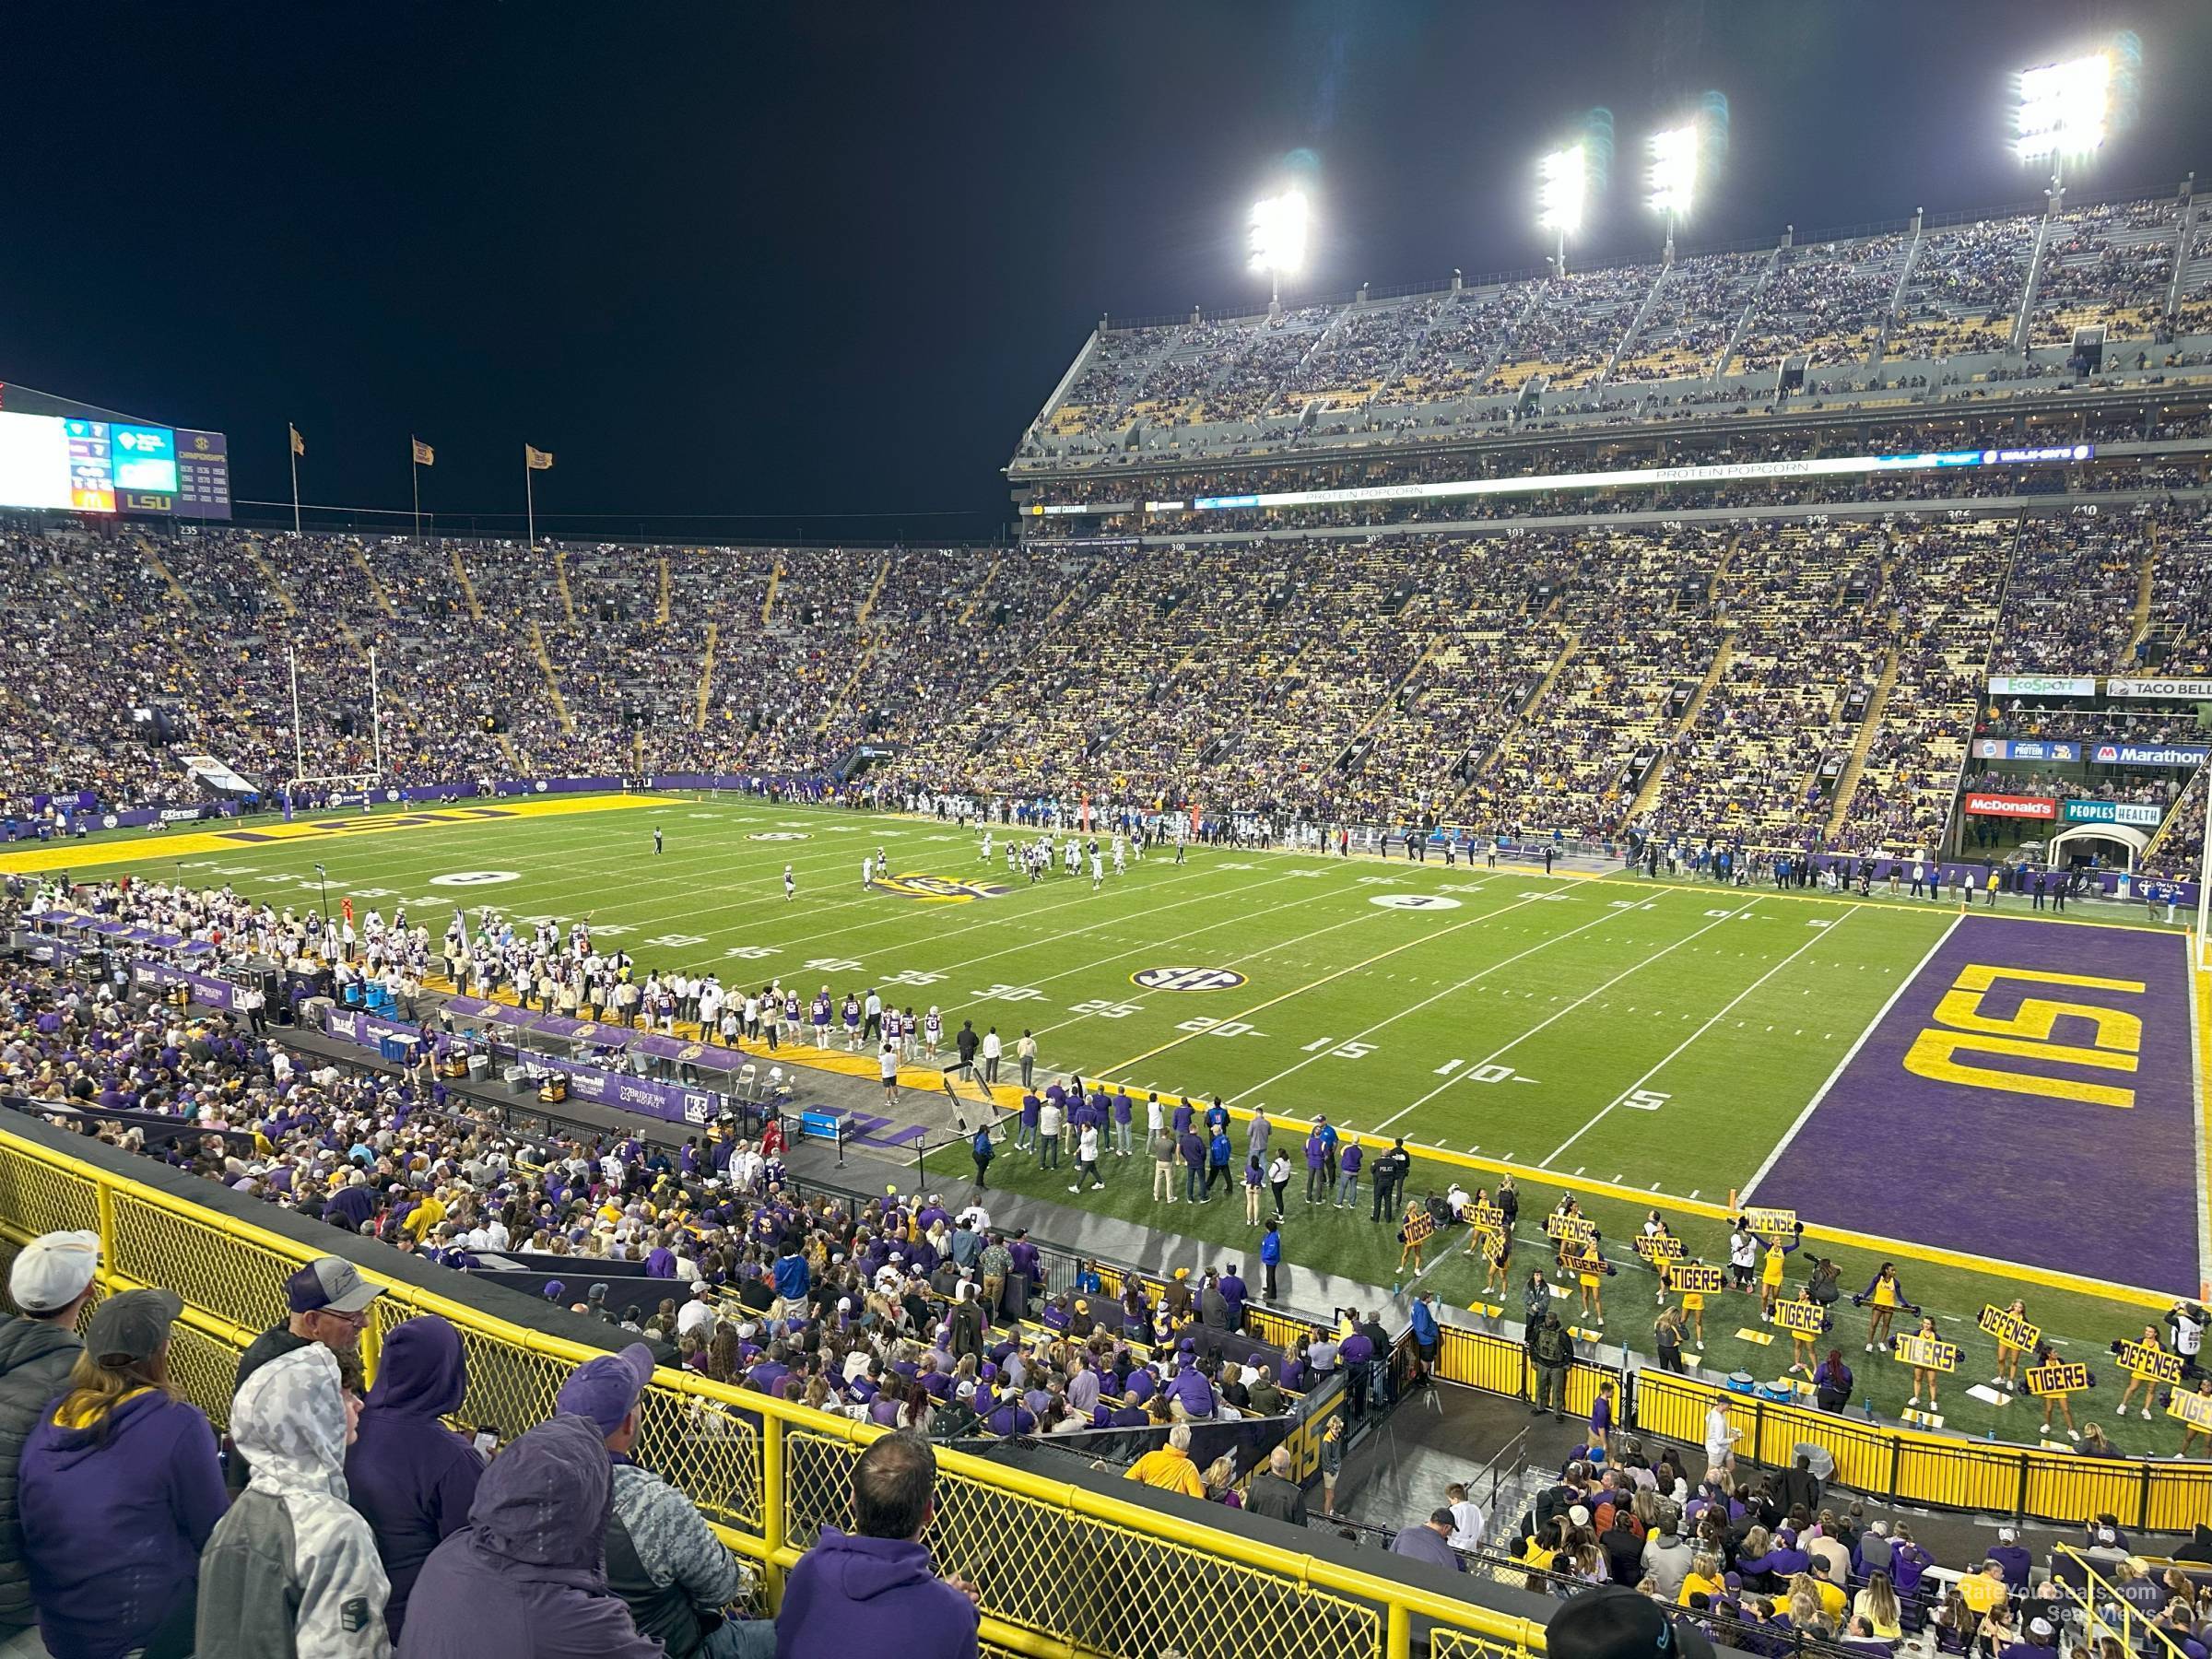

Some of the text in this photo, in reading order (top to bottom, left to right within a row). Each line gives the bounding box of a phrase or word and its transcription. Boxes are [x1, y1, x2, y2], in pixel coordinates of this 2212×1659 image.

[1656, 462, 1810, 480] PROTEIN POPCORN
[127, 493, 171, 511] LSU
[1306, 486, 1425, 501] PROTEIN POPCORN
[180, 525, 197, 535] 235
[1505, 528, 1524, 537] 303
[2008, 678, 2075, 691] EcoSport
[2136, 684, 2212, 695] TACO BELL
[2015, 746, 2043, 756] PROTEIN
[2120, 748, 2204, 764] Marathon
[623, 779, 652, 788] LU
[1971, 799, 2051, 814] McDonald's
[2070, 806, 2158, 822] PEOPLES HEALTH
[214, 808, 519, 841] LSU
[643, 934, 708, 947] 50
[724, 946, 783, 959] 45
[803, 958, 854, 972] 40
[879, 970, 950, 986] 35
[1140, 968, 1239, 990] SEC
[970, 983, 1042, 1002] 30
[786, 1003, 796, 1013] 42
[813, 1004, 823, 1015] 98
[848, 1004, 858, 1015] 68
[1068, 1000, 1146, 1018] 25
[927, 1018, 937, 1029] 43
[1174, 1017, 1254, 1037] 20
[1902, 963, 2147, 1109] LSU
[1300, 1037, 1380, 1059] 15
[1432, 1059, 1516, 1084] 10
[636, 1098, 660, 1109] HOSPICE
[1622, 1089, 1672, 1112] 5
[768, 1168, 774, 1180] 3
[1463, 1204, 1502, 1229] DEFENSE
[1747, 1209, 1794, 1232] DEFENSE
[1406, 1214, 1432, 1244] TIGERS
[1550, 1216, 1593, 1241] DEFENSE
[1638, 1237, 1680, 1259] DEFENSE
[1563, 1255, 1607, 1273] TIGERS
[1672, 1268, 1720, 1290] TIGERS
[1778, 1301, 1821, 1331] TIGERS
[1982, 1307, 2037, 1349] DEFENSE
[1899, 1336, 1954, 1369] TIGERS
[2188, 1341, 2198, 1349] 17
[2121, 1343, 2181, 1382] DEFENSE
[2029, 1366, 2084, 1392] TIGERS
[1502, 1528, 1511, 1536] 8
